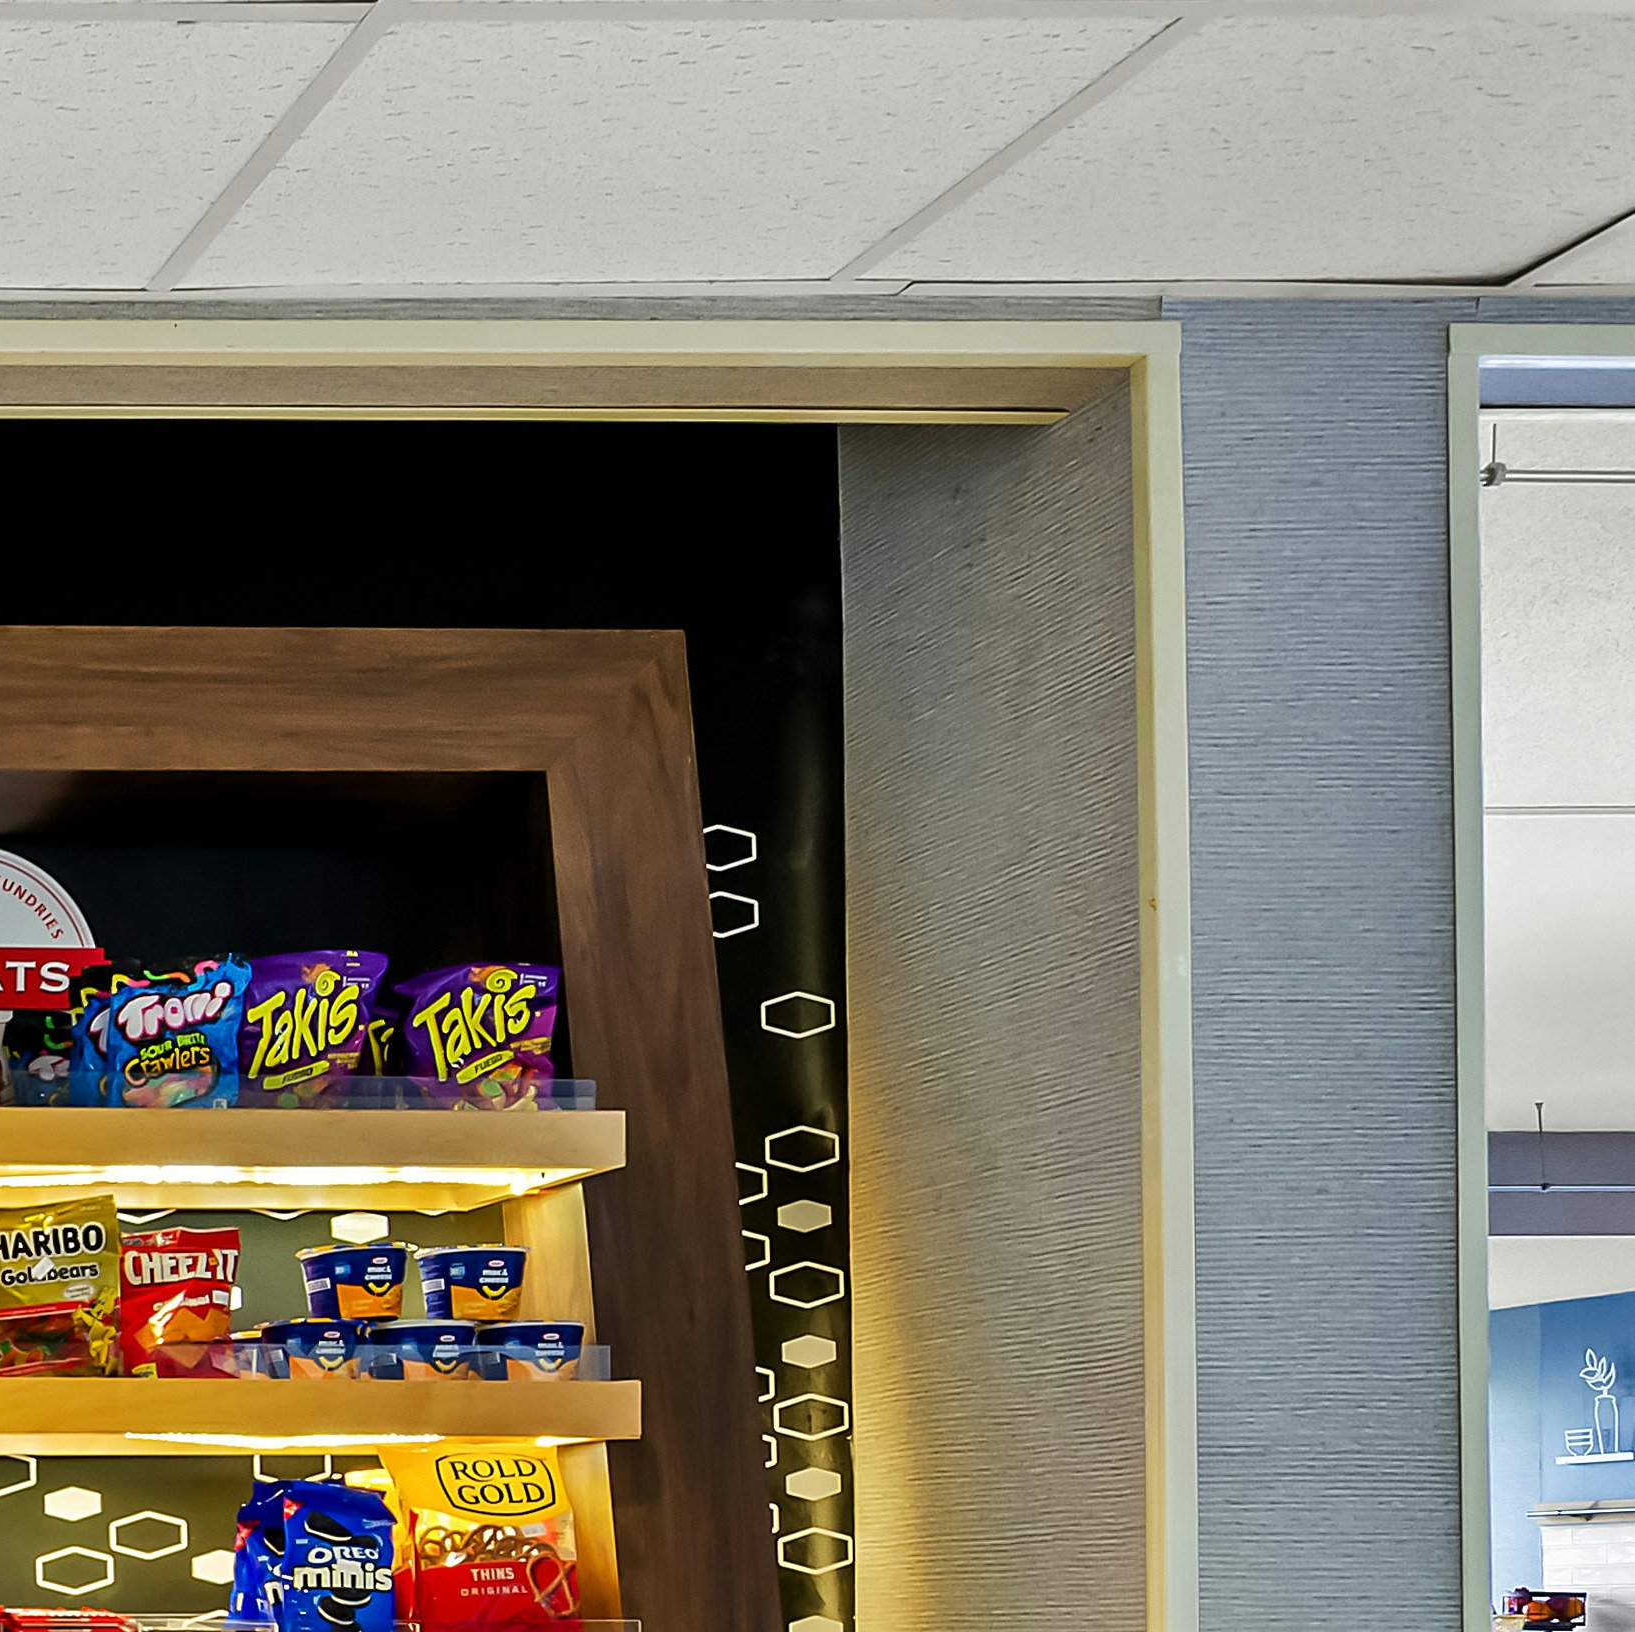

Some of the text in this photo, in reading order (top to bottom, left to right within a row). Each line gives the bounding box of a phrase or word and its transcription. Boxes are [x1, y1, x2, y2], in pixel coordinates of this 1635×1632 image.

[119, 981, 233, 1039] Trolli
[247, 970, 361, 1079] Takis
[412, 969, 537, 1082] Takis
[140, 1041, 173, 1061] SOUR
[124, 1046, 211, 1087] Crawlers
[449, 1459, 537, 1482] ROLD
[456, 1481, 546, 1505] GOLD
[307, 1544, 380, 1565] OREO
[292, 1561, 393, 1592] minis
[471, 1567, 515, 1582] THINS
[460, 1584, 529, 1598] ORIGINAL
